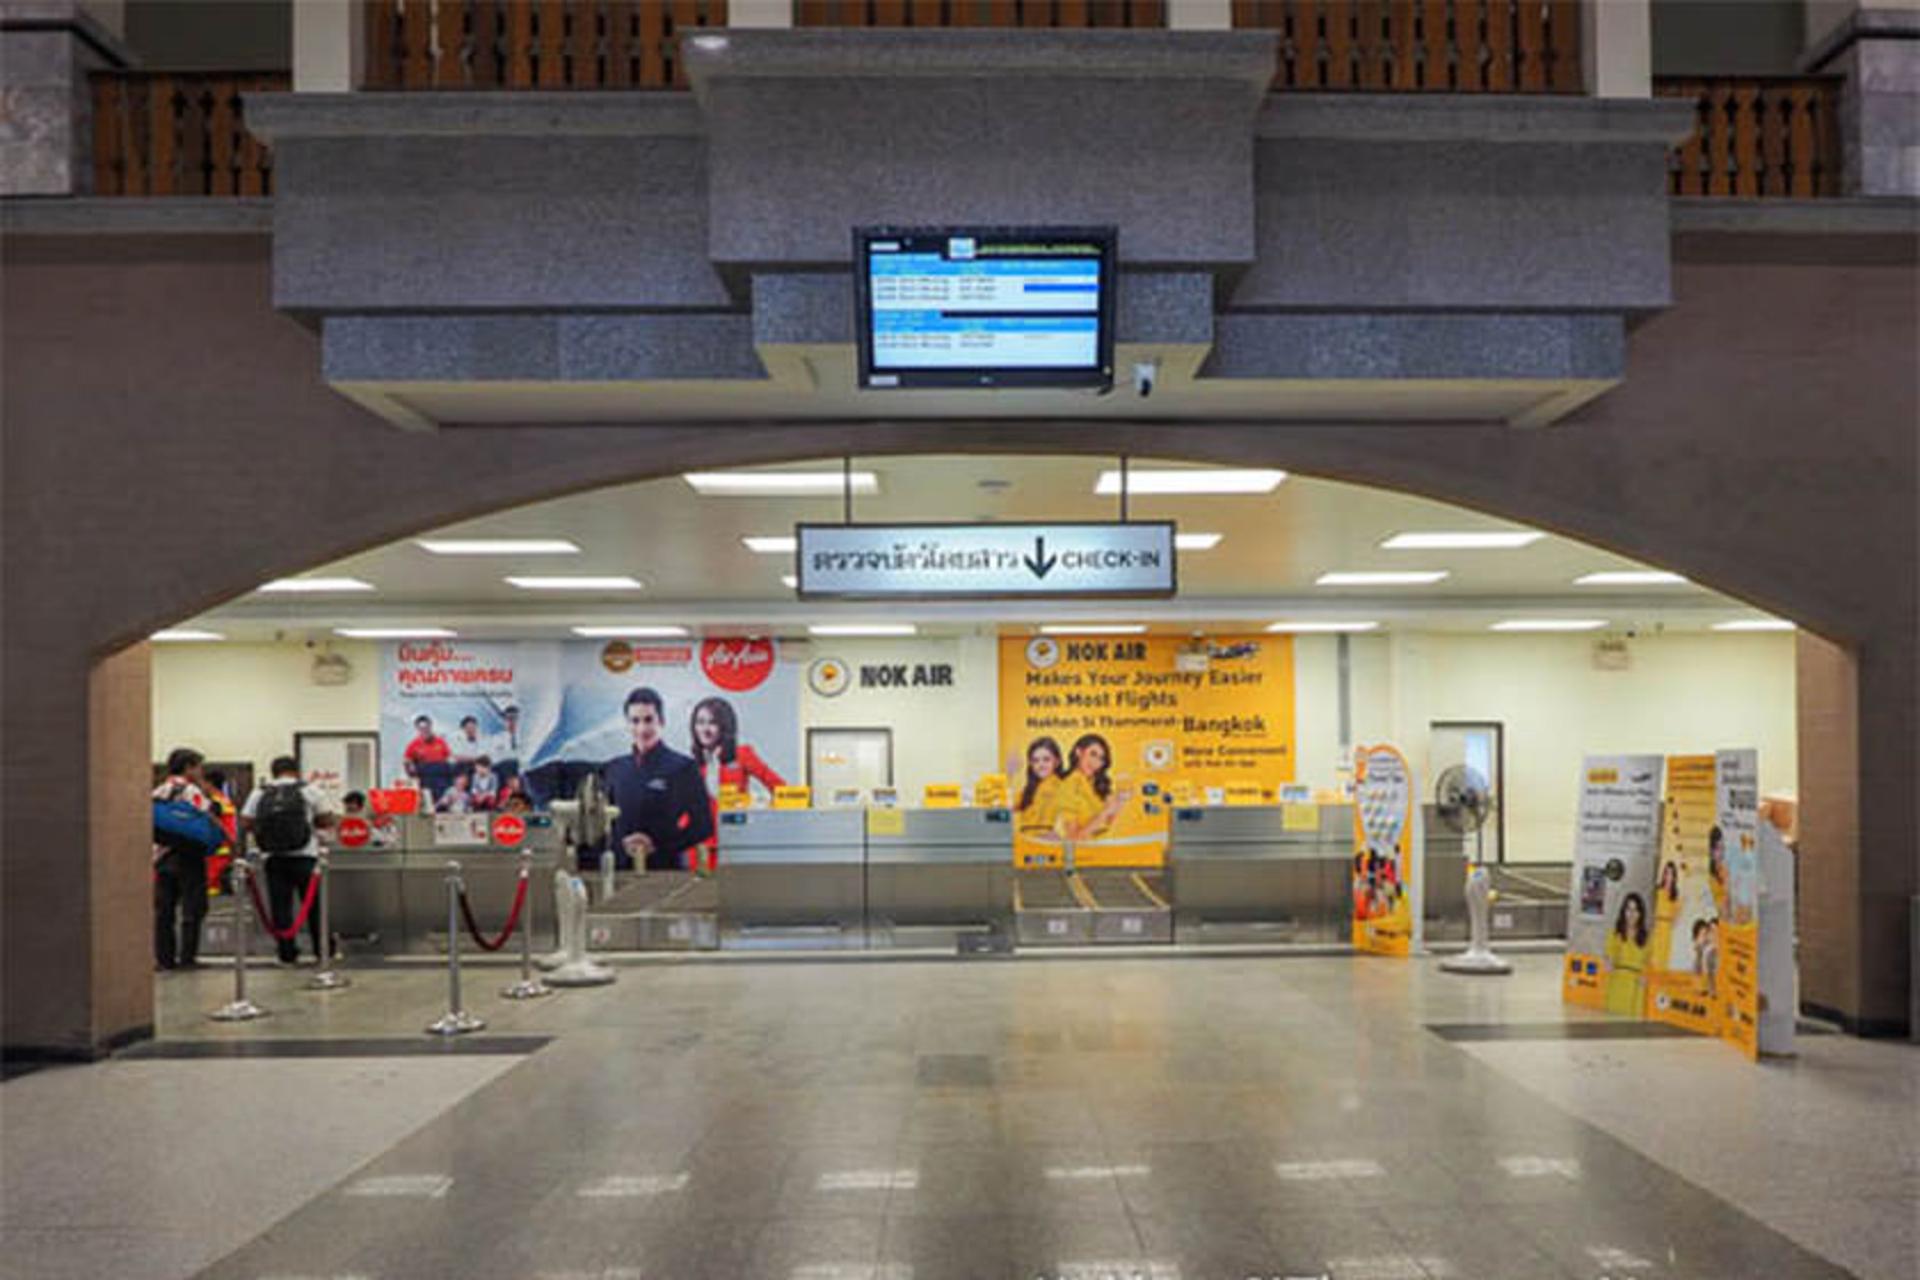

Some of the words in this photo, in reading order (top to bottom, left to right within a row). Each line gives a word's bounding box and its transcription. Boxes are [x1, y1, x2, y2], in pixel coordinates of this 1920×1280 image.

[1061, 550, 1160, 570] CHECK-IN
[1067, 642, 1108, 661] NOK
[1113, 642, 1147, 660] AIR
[860, 664, 908, 688] NOK
[911, 664, 953, 687] AIR
[1026, 670, 1081, 686] Makes
[1089, 671, 1127, 686] Your
[1133, 670, 1202, 689] Journey
[1210, 669, 1264, 686] Easier
[1066, 692, 1109, 707] Most
[1115, 689, 1178, 710] Flights
[1183, 714, 1266, 738] Bangkok
